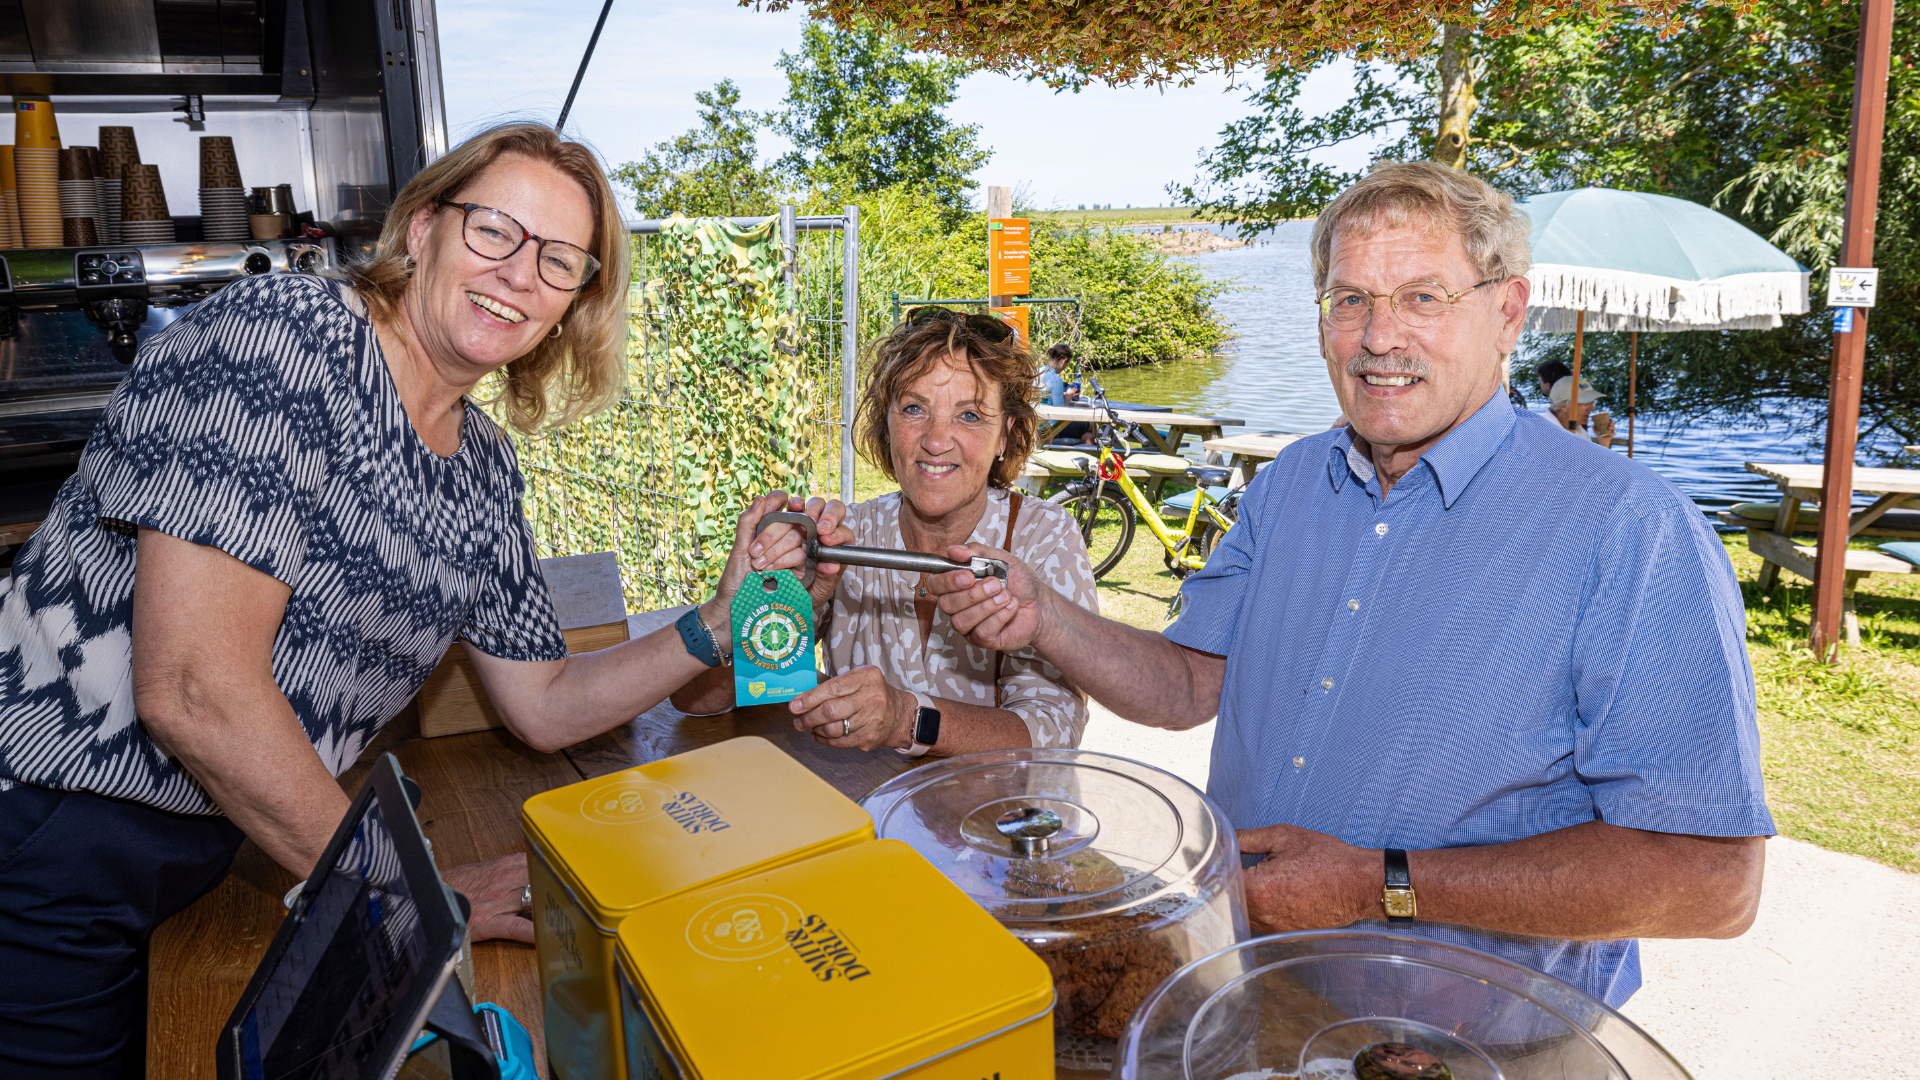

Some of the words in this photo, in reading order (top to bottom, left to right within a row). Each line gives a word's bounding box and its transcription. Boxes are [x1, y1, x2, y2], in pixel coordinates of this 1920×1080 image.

[741, 616, 754, 637] NIEUW
[752, 604, 769, 618] LAND
[770, 603, 795, 615] ESCAPE
[793, 612, 808, 633] ROUTE
[741, 640, 756, 661] ROUTE
[795, 636, 809, 658] NIEUW
[753, 658, 779, 670] ESCAPE
[780, 656, 797, 669] LAND
[673, 791, 731, 833] DORLAS
[798, 914, 872, 982] DORLAS
